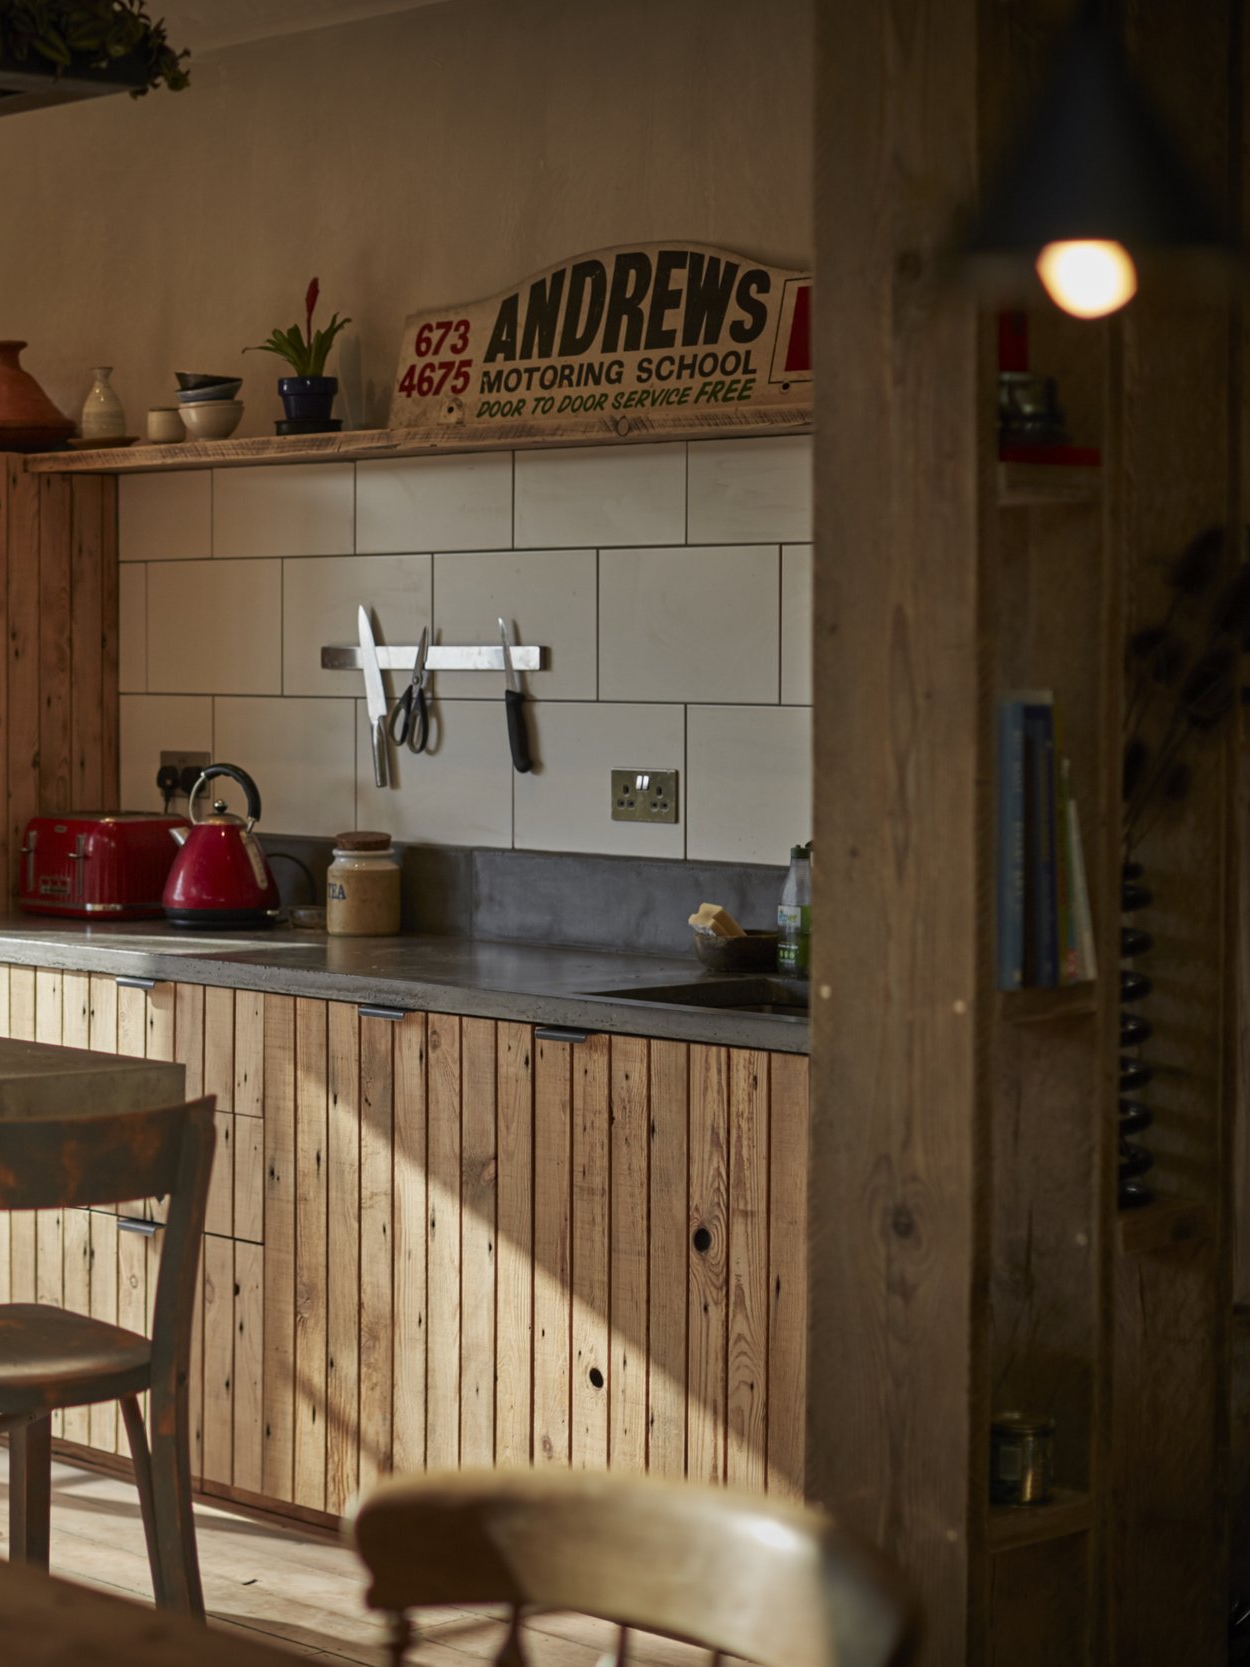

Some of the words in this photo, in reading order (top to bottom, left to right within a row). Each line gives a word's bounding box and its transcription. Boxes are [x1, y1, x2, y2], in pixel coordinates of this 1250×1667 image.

[482, 249, 771, 364] ANDREWS
[414, 318, 471, 358] 673
[397, 358, 473, 398] 4675
[479, 359, 625, 394] MOTORING
[635, 349, 757, 384] SCHOOL
[476, 398, 527, 418] DOOR
[531, 396, 556, 415] TO
[557, 392, 609, 413] DOOR
[611, 386, 694, 410] SERVICE
[693, 377, 757, 405] FREE
